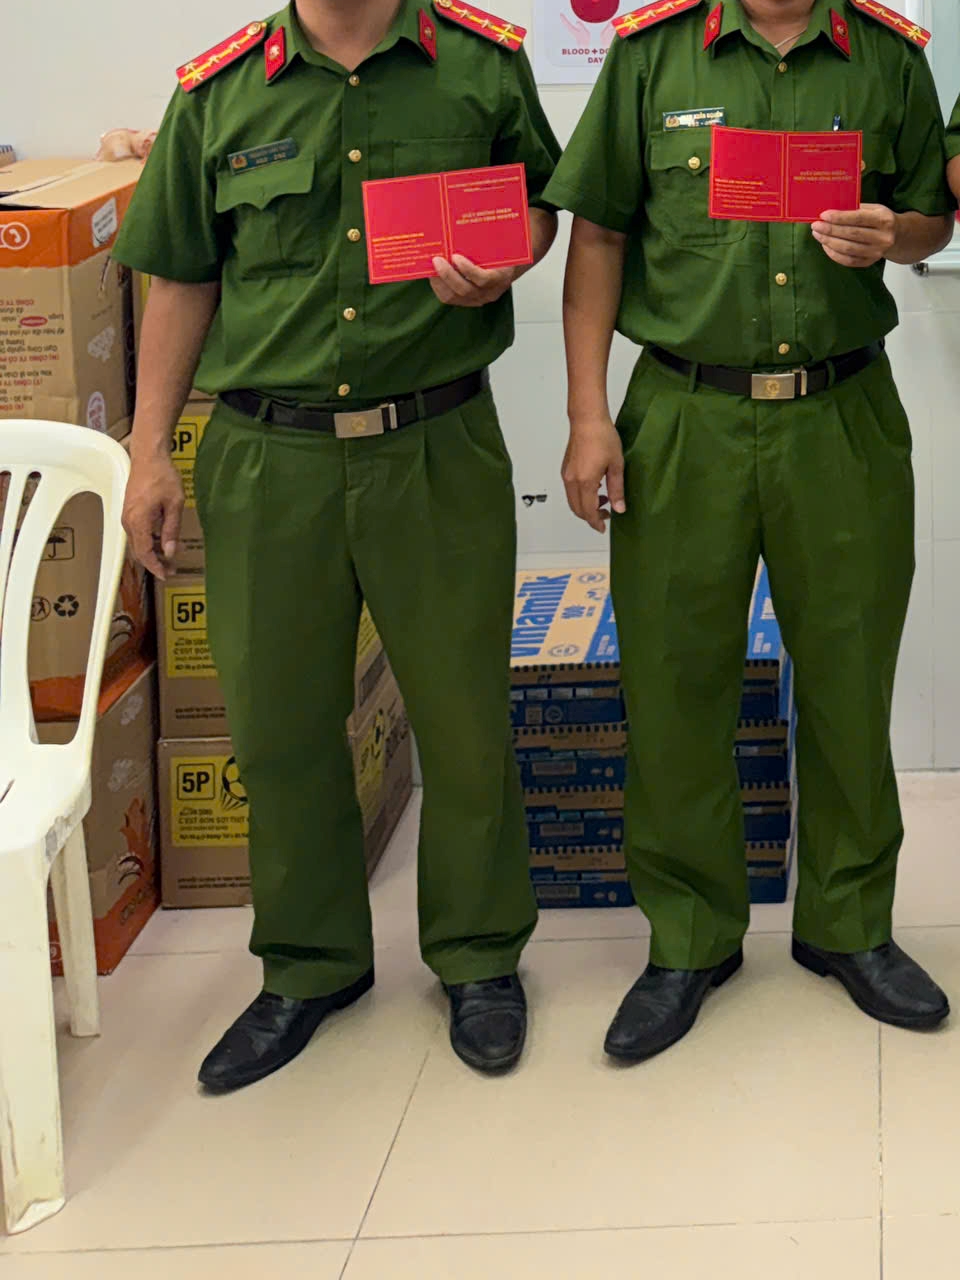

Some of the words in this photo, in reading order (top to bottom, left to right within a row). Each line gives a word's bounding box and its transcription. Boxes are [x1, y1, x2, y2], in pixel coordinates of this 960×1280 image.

[562, 48, 590, 56] BLOOD
[177, 602, 205, 624] 5P
[182, 771, 210, 793] 5P
